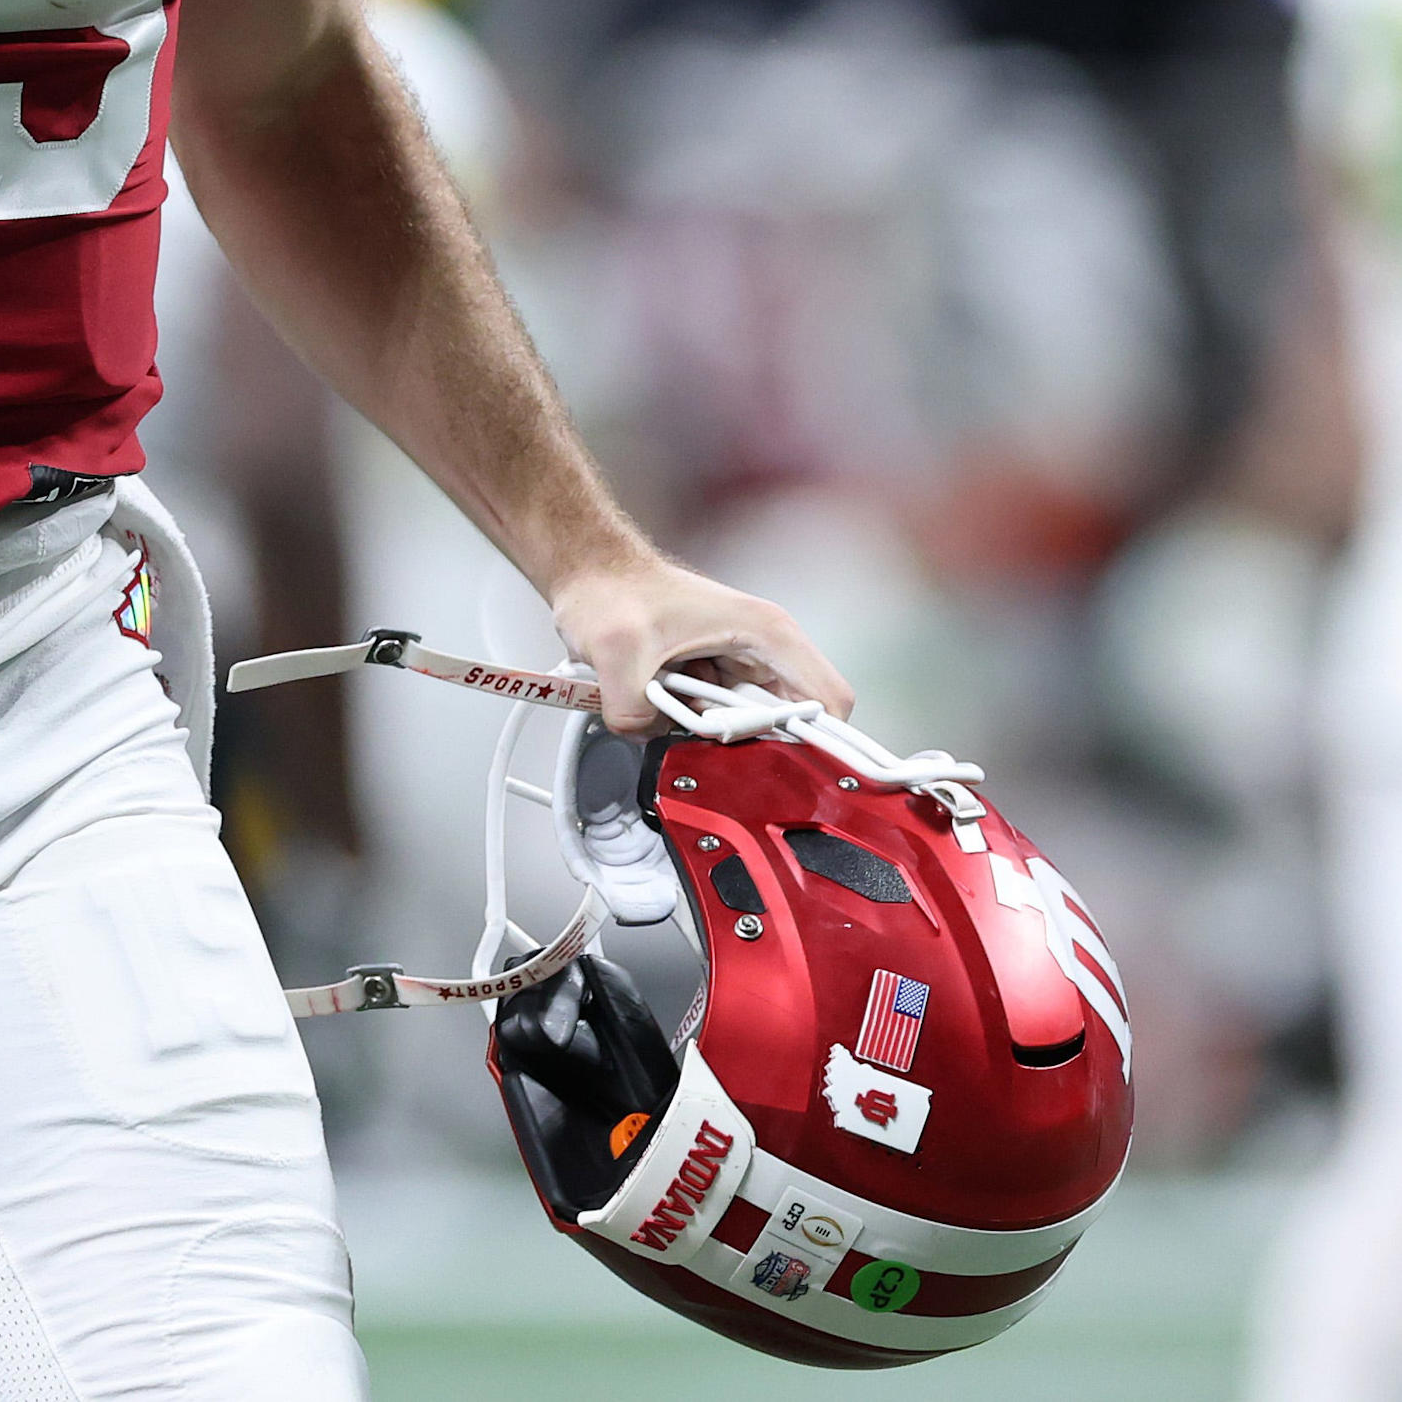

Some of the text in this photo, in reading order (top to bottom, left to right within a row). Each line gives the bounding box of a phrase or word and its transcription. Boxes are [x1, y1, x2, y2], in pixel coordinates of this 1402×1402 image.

[463, 666, 538, 699] SPORT
[454, 974, 523, 999] SPORT
[630, 1119, 734, 1252] INDIANA
[784, 1202, 805, 1232] CFP
[759, 1254, 791, 1292] PEACH
[873, 1266, 905, 1309] C2P
